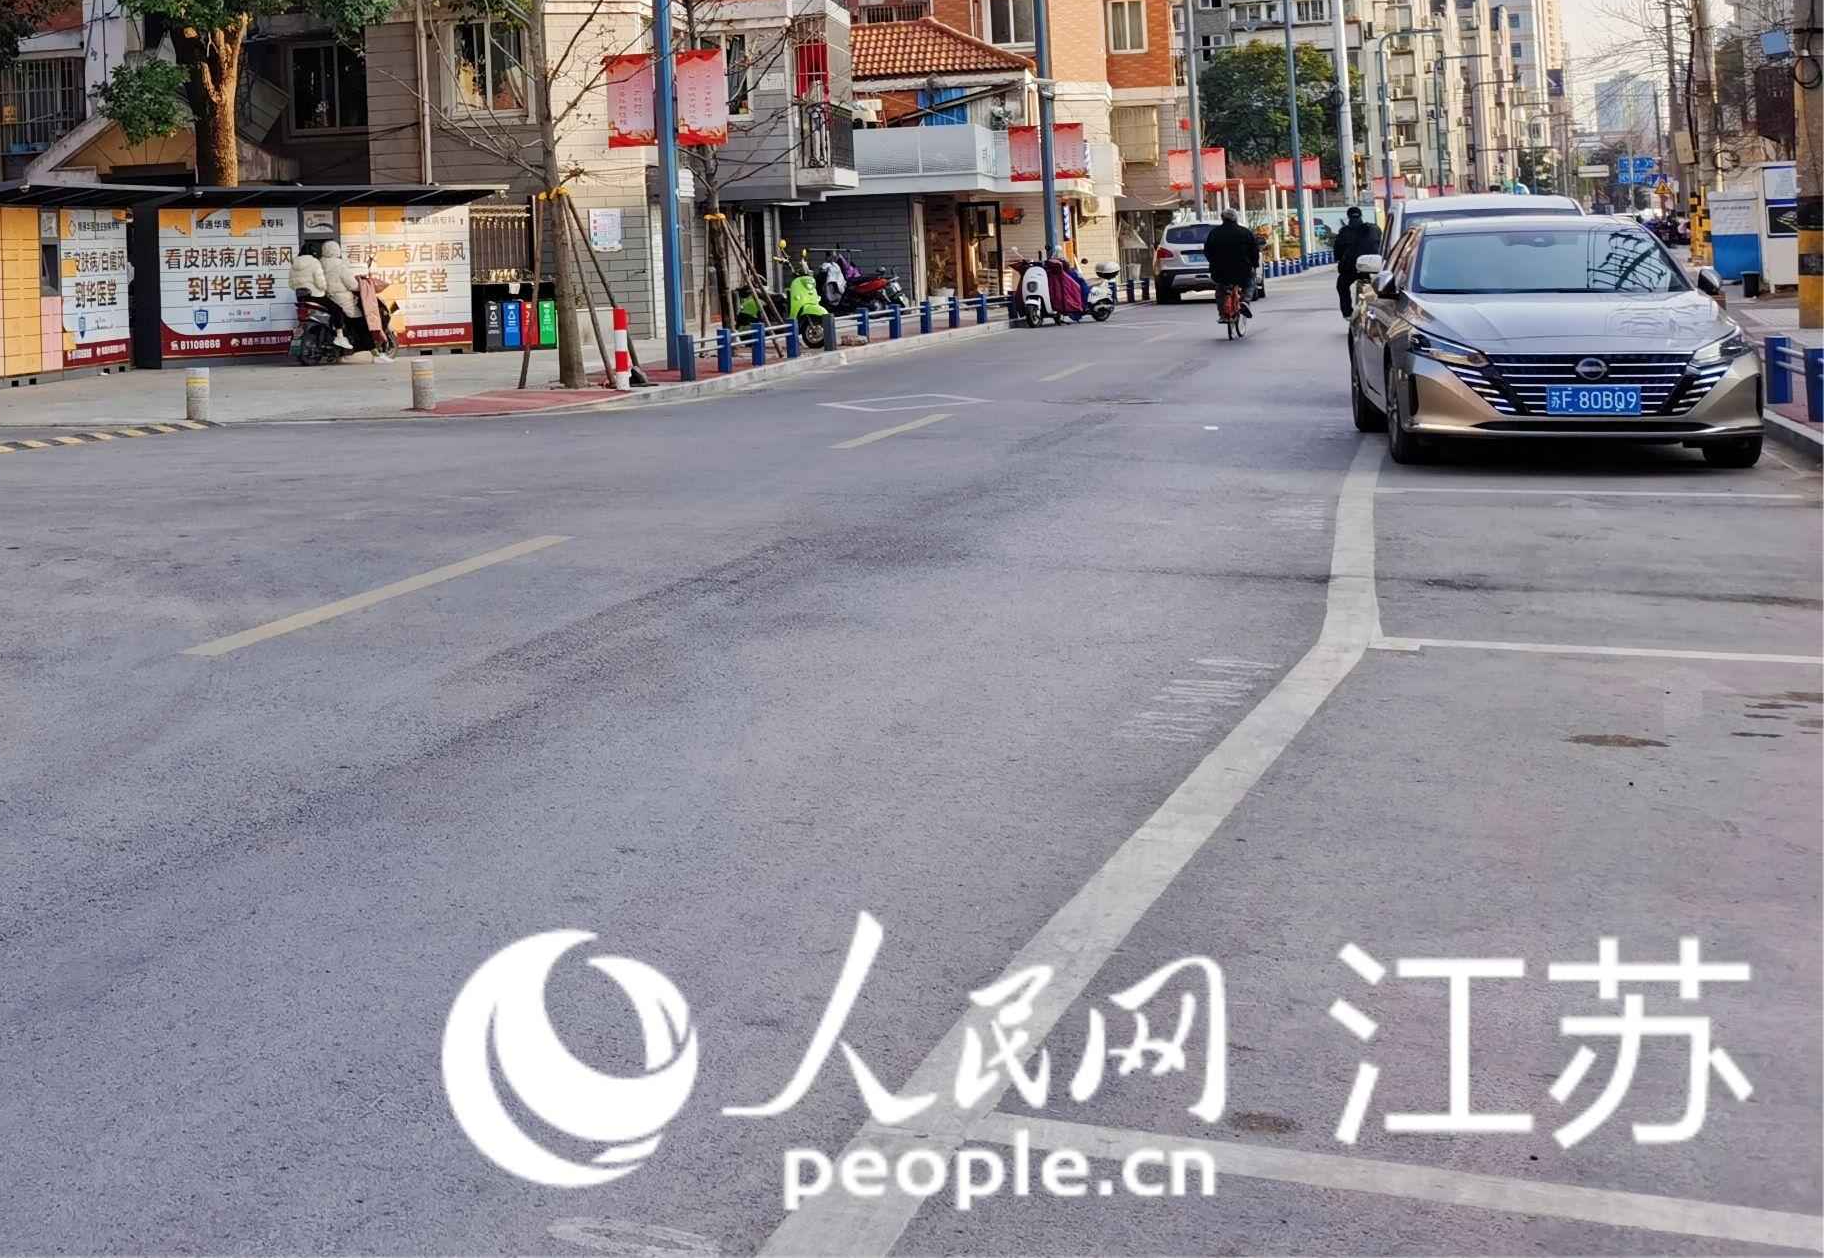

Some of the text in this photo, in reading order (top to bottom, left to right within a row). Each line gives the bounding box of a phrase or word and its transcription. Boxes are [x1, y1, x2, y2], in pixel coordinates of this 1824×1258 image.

[75, 279, 117, 309] 到华医堂
[187, 274, 276, 302] 到华医堂
